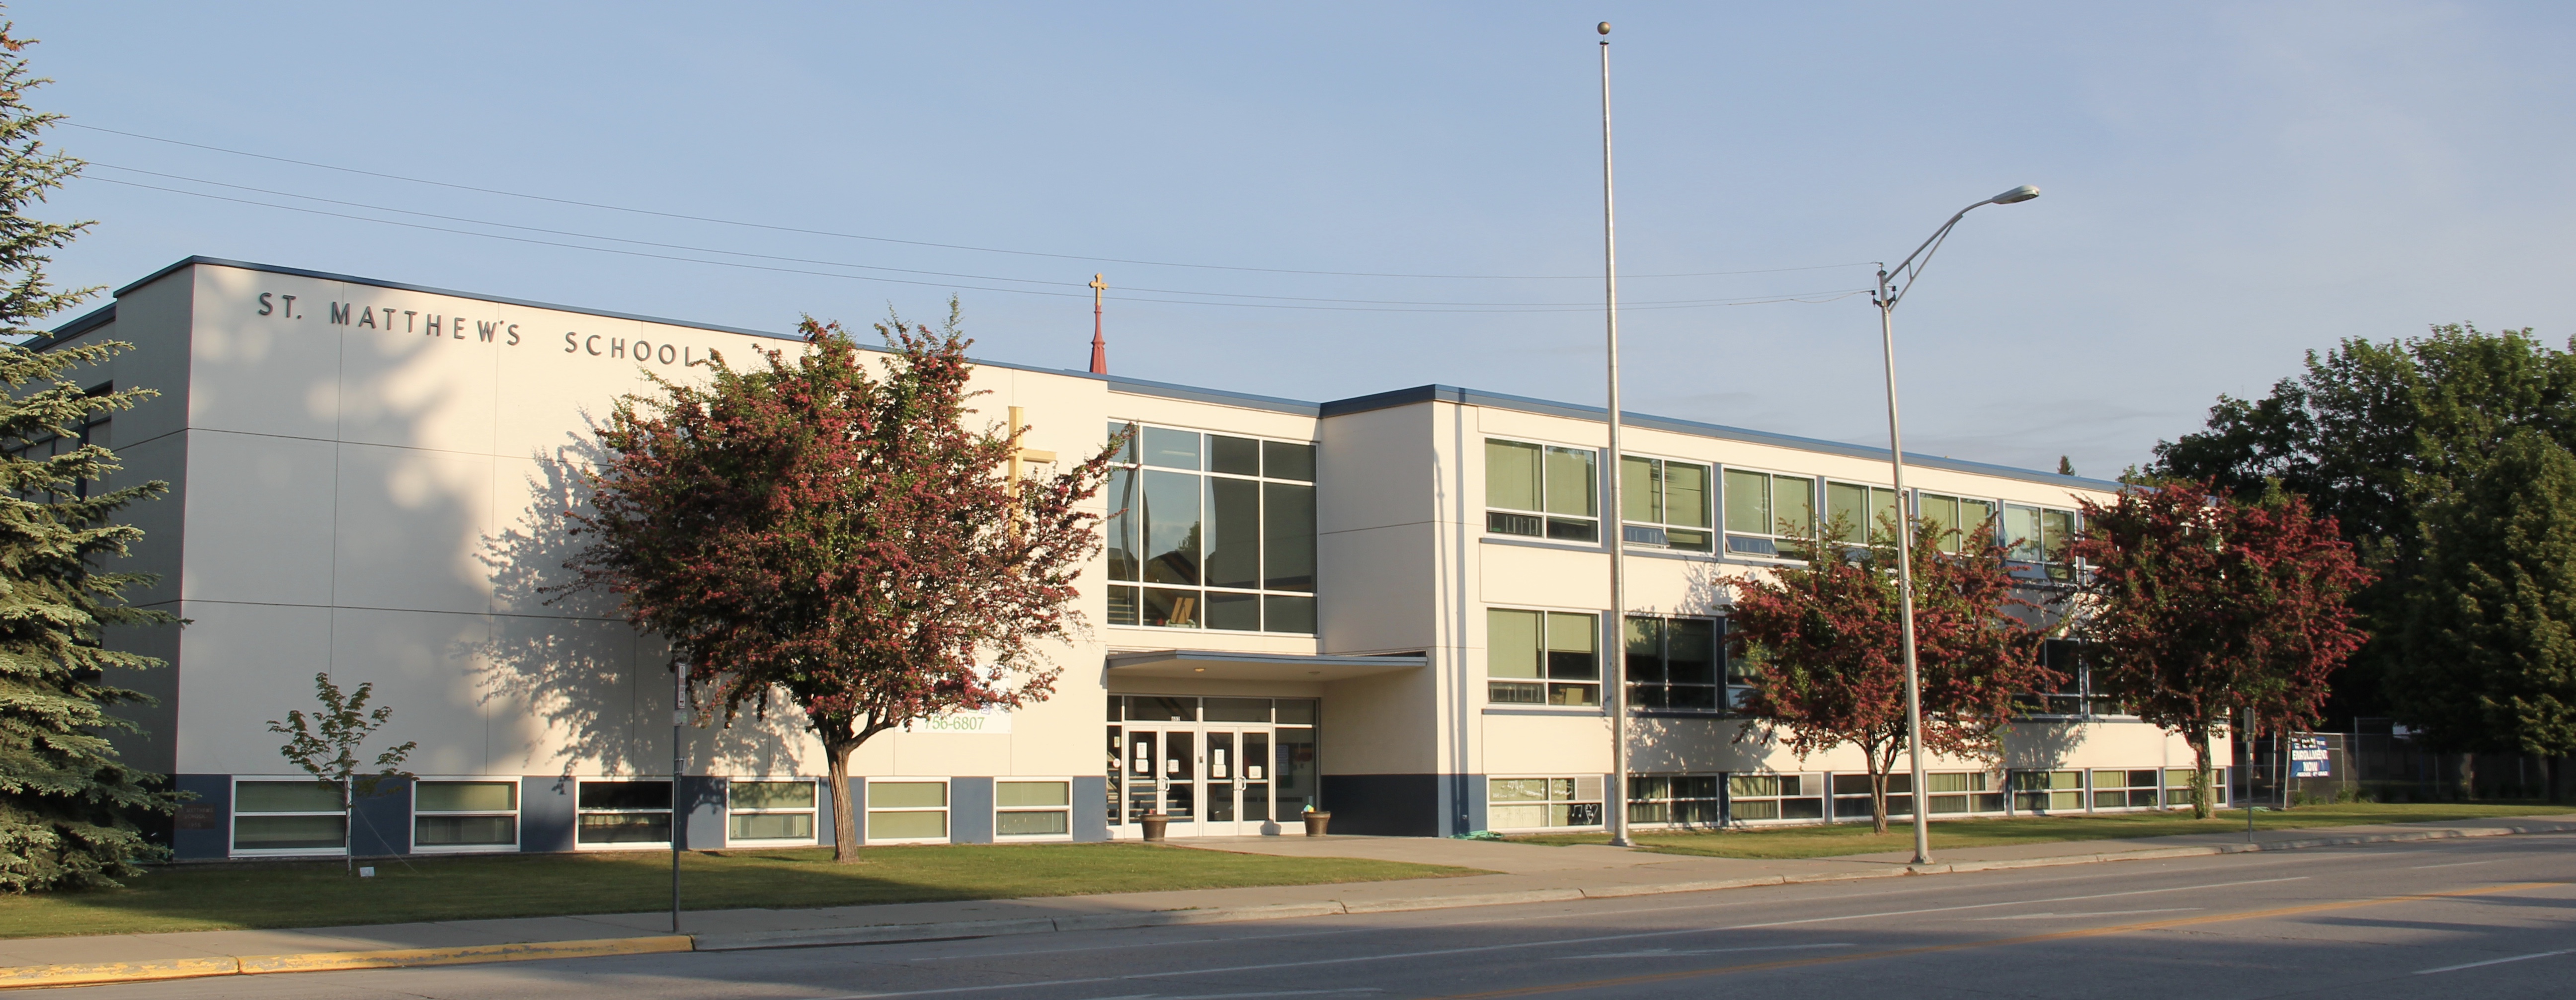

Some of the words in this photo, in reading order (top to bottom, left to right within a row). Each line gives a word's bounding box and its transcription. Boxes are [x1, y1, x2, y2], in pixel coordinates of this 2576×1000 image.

[258, 292, 302, 319] ST.
[330, 301, 520, 346] MATTHEW'S
[564, 331, 694, 367] SCHOOL
[925, 716, 985, 730] 756-6807
[2292, 750, 2329, 761] ENROLLMENT
[2303, 761, 2319, 771] NOW
